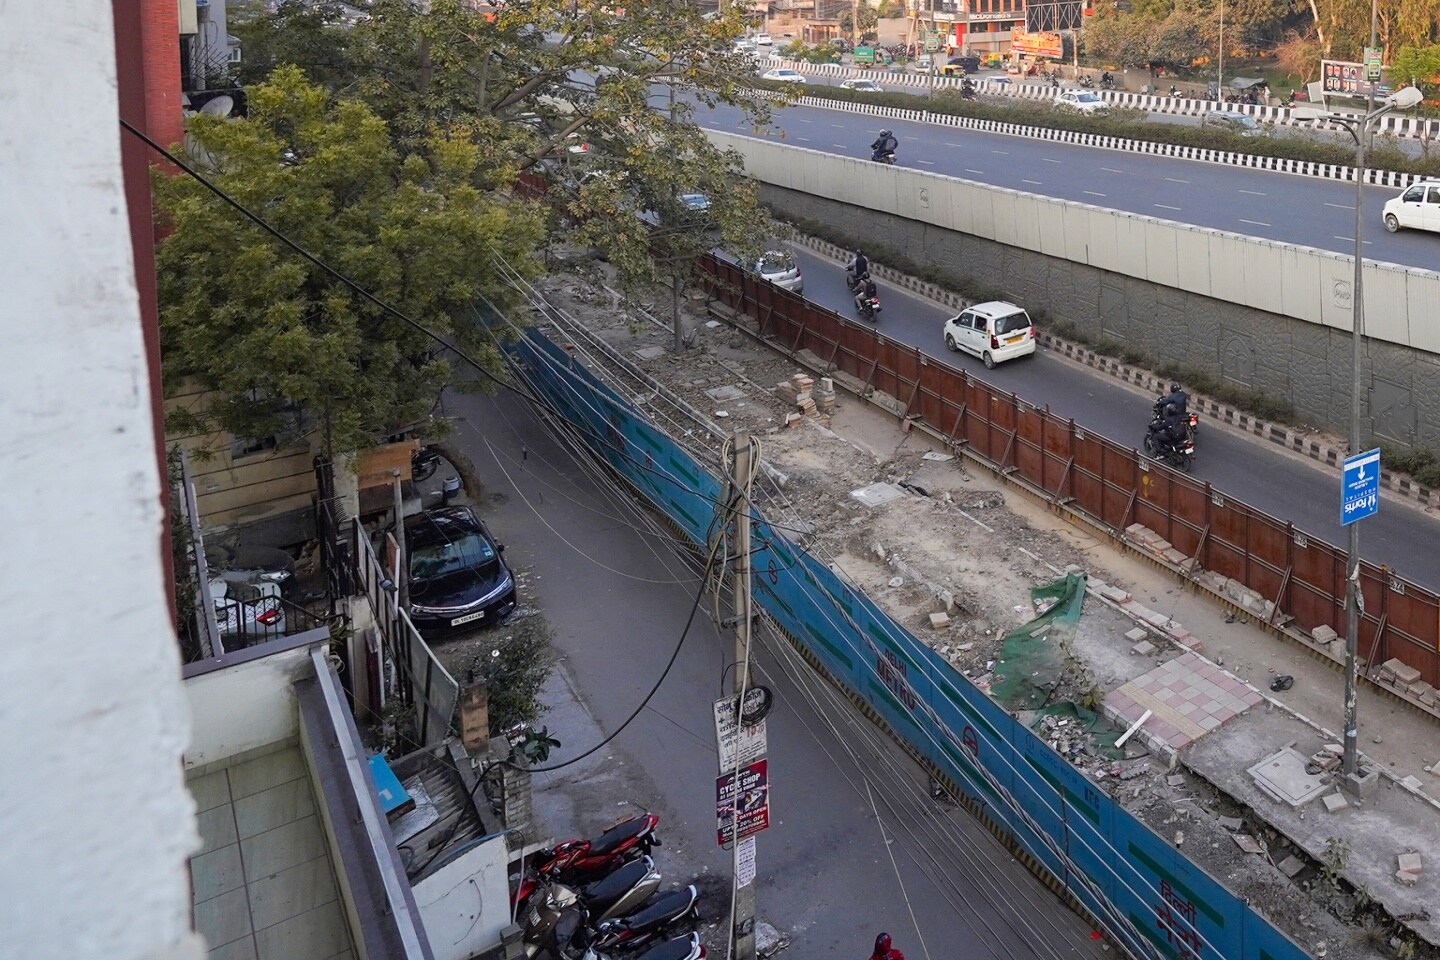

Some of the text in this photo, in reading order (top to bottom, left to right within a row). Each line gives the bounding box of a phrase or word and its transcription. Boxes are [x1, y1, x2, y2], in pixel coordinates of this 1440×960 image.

[1345, 487, 1376, 500] HOSPITAL
[1345, 498, 1366, 514] Fortis
[720, 782, 741, 795] CYCE
[742, 772, 760, 784] SHOP
